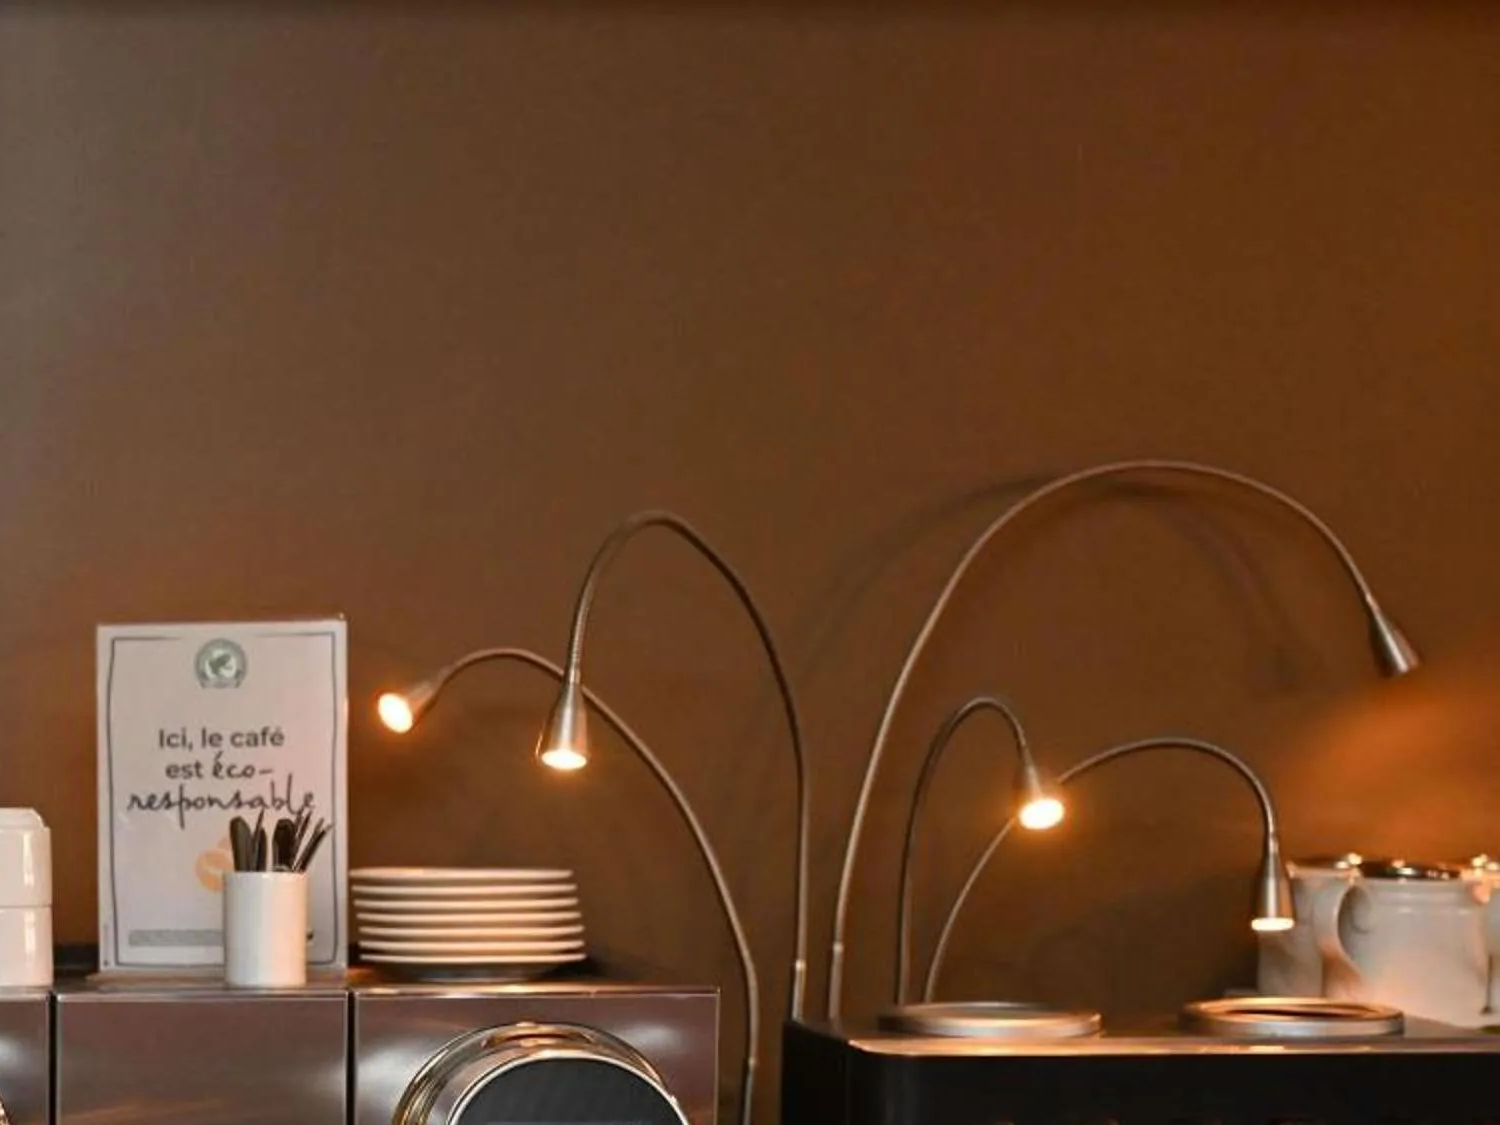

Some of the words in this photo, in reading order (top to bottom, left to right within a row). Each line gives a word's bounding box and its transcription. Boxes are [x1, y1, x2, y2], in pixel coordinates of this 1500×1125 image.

[158, 727, 193, 750] Ici,
[201, 728, 223, 748] le
[231, 726, 285, 748] café
[166, 760, 203, 779] est
[127, 773, 316, 831] responsable
